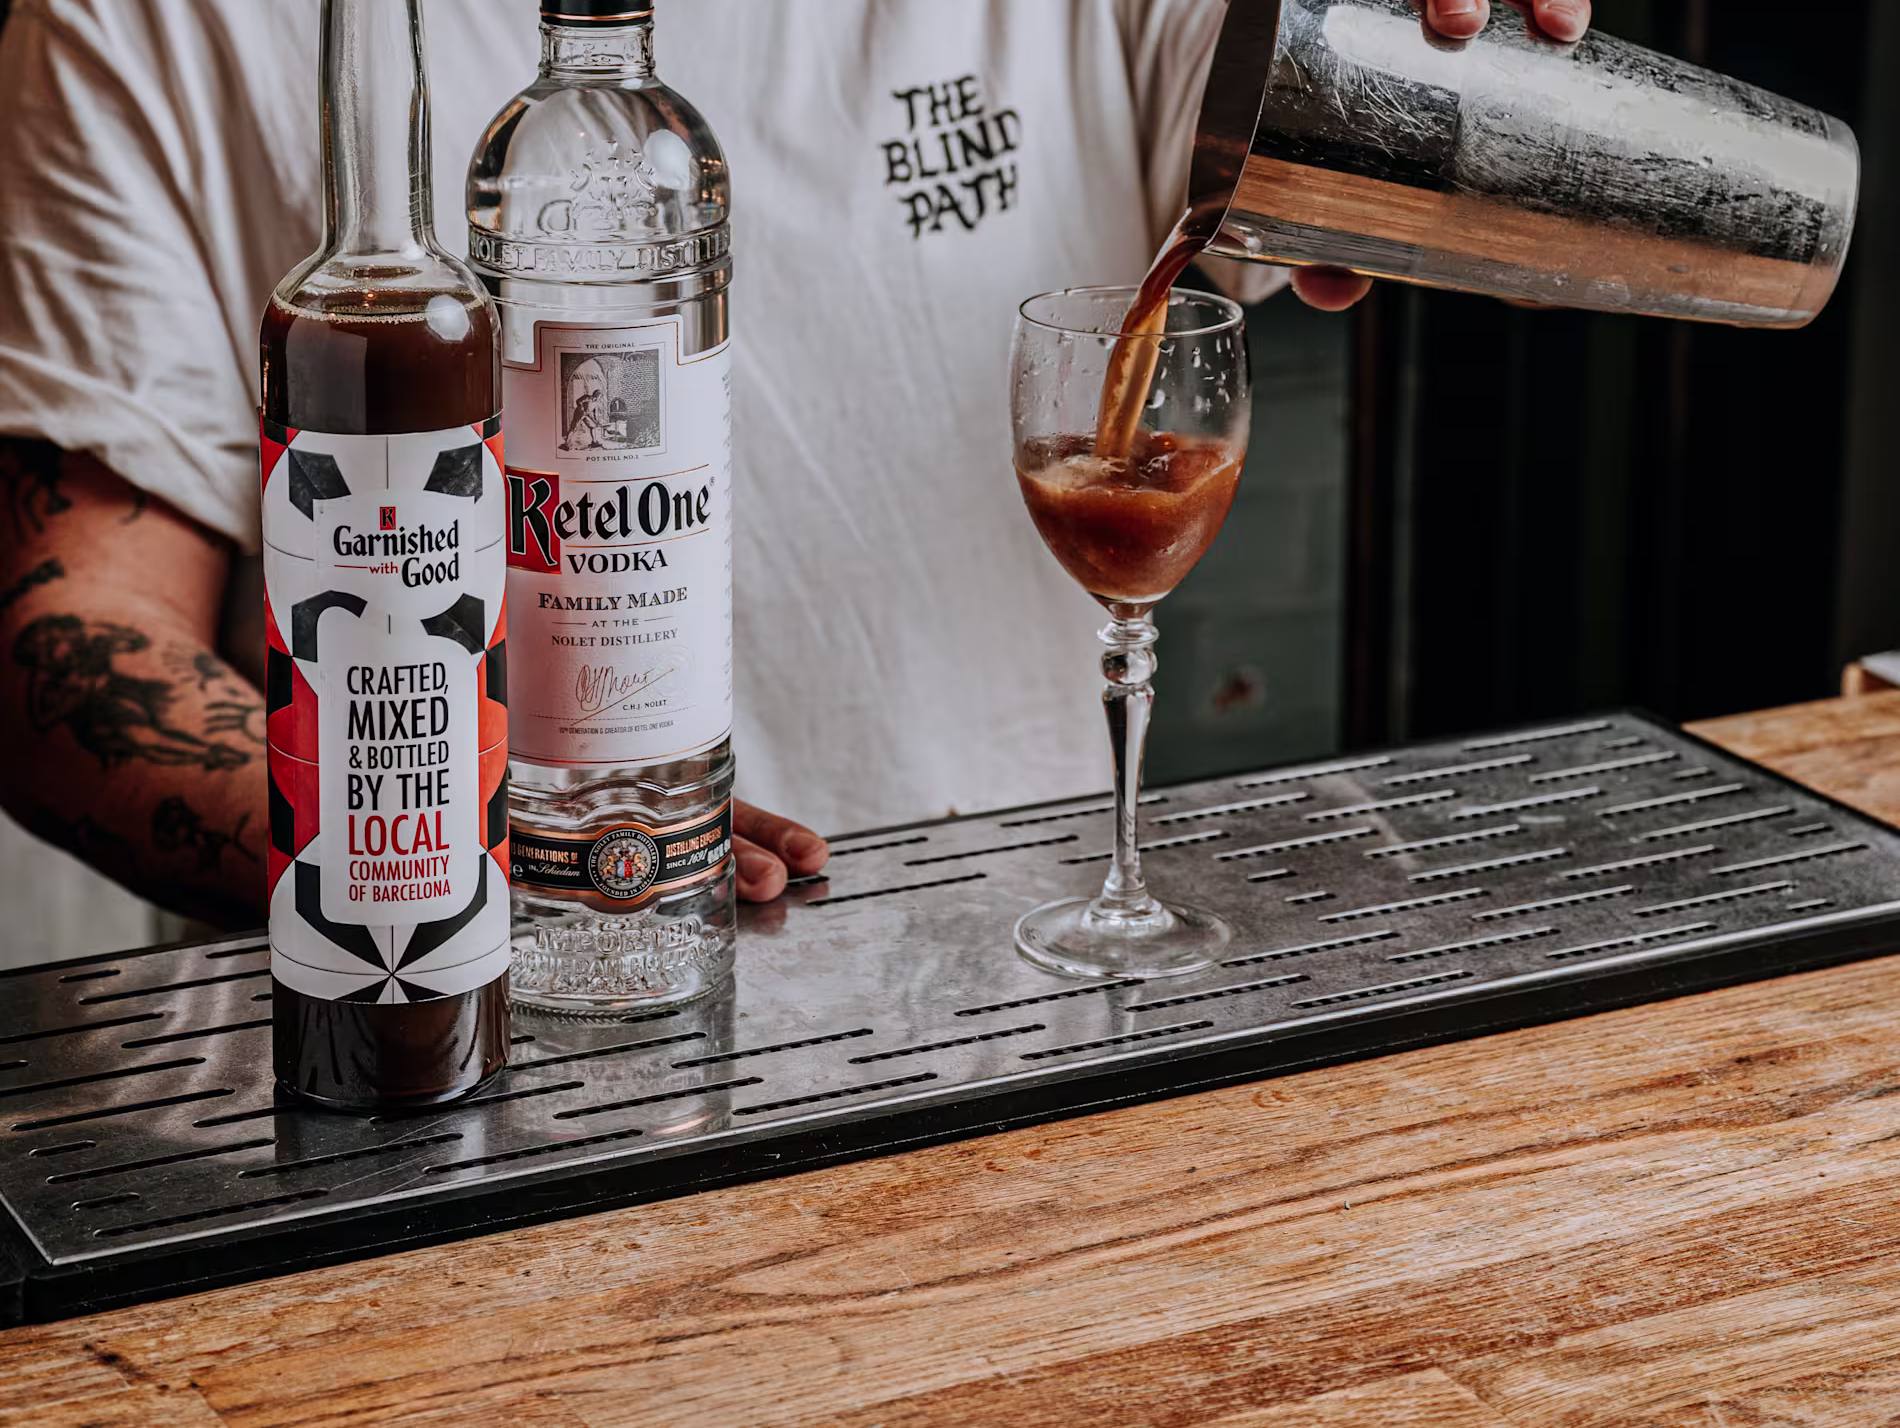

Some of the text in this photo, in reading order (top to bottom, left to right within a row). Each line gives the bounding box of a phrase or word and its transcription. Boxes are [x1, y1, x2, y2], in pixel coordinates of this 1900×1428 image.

[891, 75, 985, 131] THE
[879, 109, 1021, 186] BLIND
[898, 164, 1016, 239] PATH
[601, 342, 636, 350] ORIGINAL
[506, 474, 711, 566] Ketel One
[333, 519, 459, 557] Garnished
[369, 551, 460, 588] with Good
[566, 548, 668, 574] VODKA
[538, 586, 688, 611] FAMILY MADE
[592, 618, 639, 628] AT THE
[551, 628, 678, 647] NOLET DISTILLERY
[347, 662, 449, 695] CRAFTED,
[644, 699, 667, 709] NOLET
[347, 696, 449, 741] MIXED
[569, 727, 599, 735] GENERATION
[605, 726, 627, 734] CREATOR
[349, 740, 449, 770] & BOTTLED
[348, 768, 450, 811] BY THE
[348, 811, 450, 857] LOCAL
[665, 836, 700, 858] DISTILLING
[518, 843, 569, 863] GENERATIONS
[666, 859, 687, 870] SINCE
[349, 855, 449, 881] COMMUNITY
[349, 879, 451, 902] OF BARCELONA
